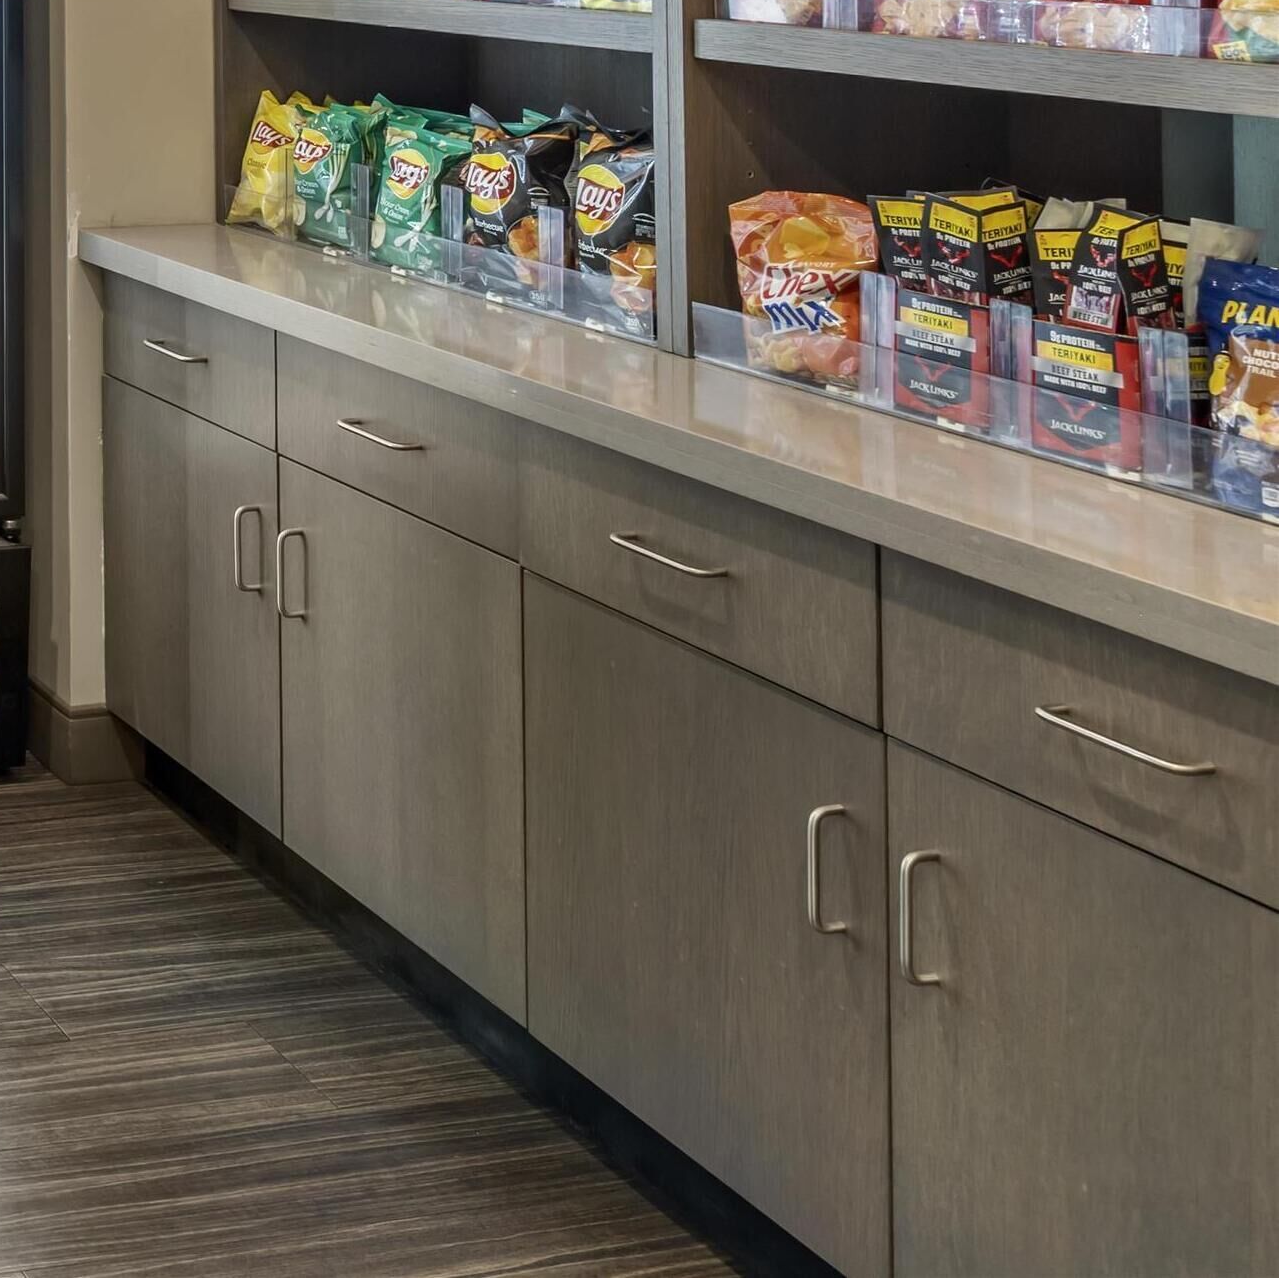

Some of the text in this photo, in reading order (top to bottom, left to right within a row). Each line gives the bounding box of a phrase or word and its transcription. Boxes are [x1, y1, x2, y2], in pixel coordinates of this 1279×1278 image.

[465, 162, 511, 198] Lay's
[576, 178, 622, 219] Lay's
[933, 217, 974, 239] TERIYAKI
[982, 223, 1023, 240] TERIYAKI
[913, 312, 953, 330] TERIYAKI
[1061, 333, 1096, 350] PROTEIN
[1052, 346, 1096, 364] TERIYAKI
[1073, 368, 1099, 382] STEAK
[910, 379, 930, 394] JACK
[1050, 419, 1074, 435] JACK
